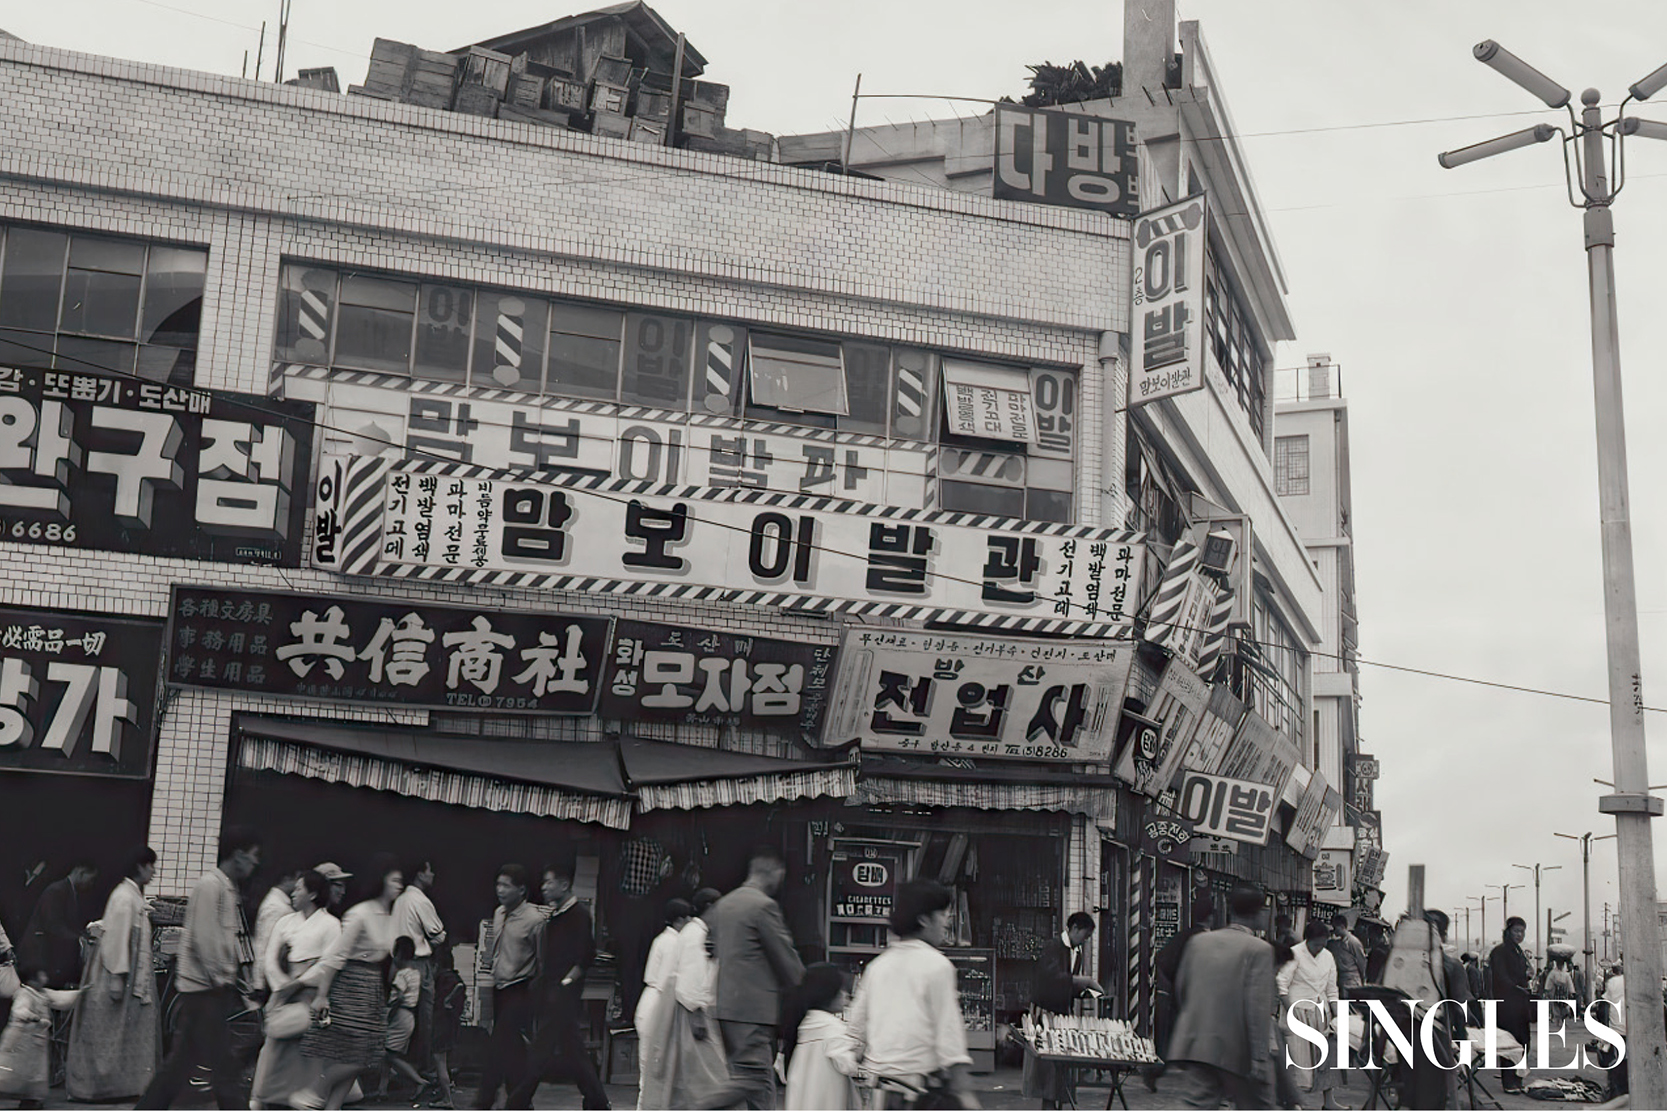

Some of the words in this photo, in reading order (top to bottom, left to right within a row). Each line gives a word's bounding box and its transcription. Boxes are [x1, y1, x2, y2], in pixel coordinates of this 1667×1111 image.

[999, 109, 1120, 204] 다방
[1143, 233, 1189, 371] 이발
[42, 372, 121, 404] 또뽑기
[139, 383, 211, 414] 도산매
[0, 519, 76, 542] )6686
[313, 458, 343, 565] 이발
[179, 597, 272, 625] 各種文房具
[0, 625, 107, 656] 必需品一切
[179, 625, 268, 655] 事務用品
[275, 606, 590, 698] 共信商社
[661, 630, 754, 657] 도산매
[175, 655, 266, 685] 學生用品
[611, 638, 644, 697] 화성
[641, 650, 805, 717] 모자점
[871, 668, 1093, 748] 전업사
[1145, 820, 1191, 846] 공중전화
[1181, 777, 1273, 841] 이발
